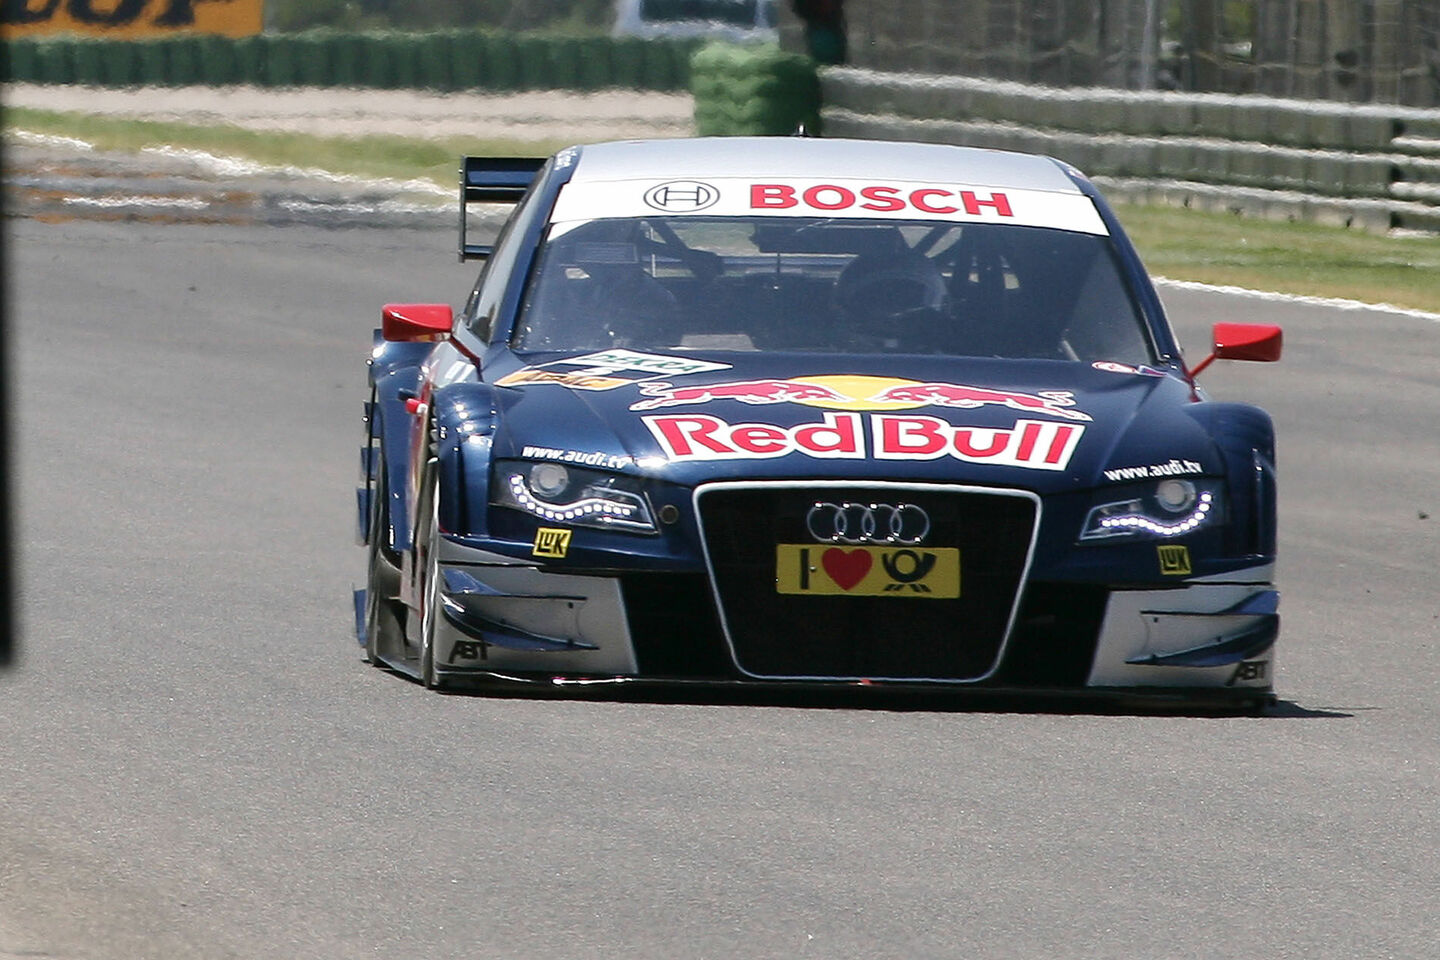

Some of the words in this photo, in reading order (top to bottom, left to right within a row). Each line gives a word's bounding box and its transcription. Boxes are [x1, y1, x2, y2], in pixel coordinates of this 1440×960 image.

[749, 184, 1014, 218] BOSCH
[583, 353, 700, 372] DEKRA
[652, 414, 857, 456] Red
[881, 417, 1075, 465] Bull
[522, 445, 630, 469] www.audi.tv
[1104, 459, 1203, 481] www.audi.tv
